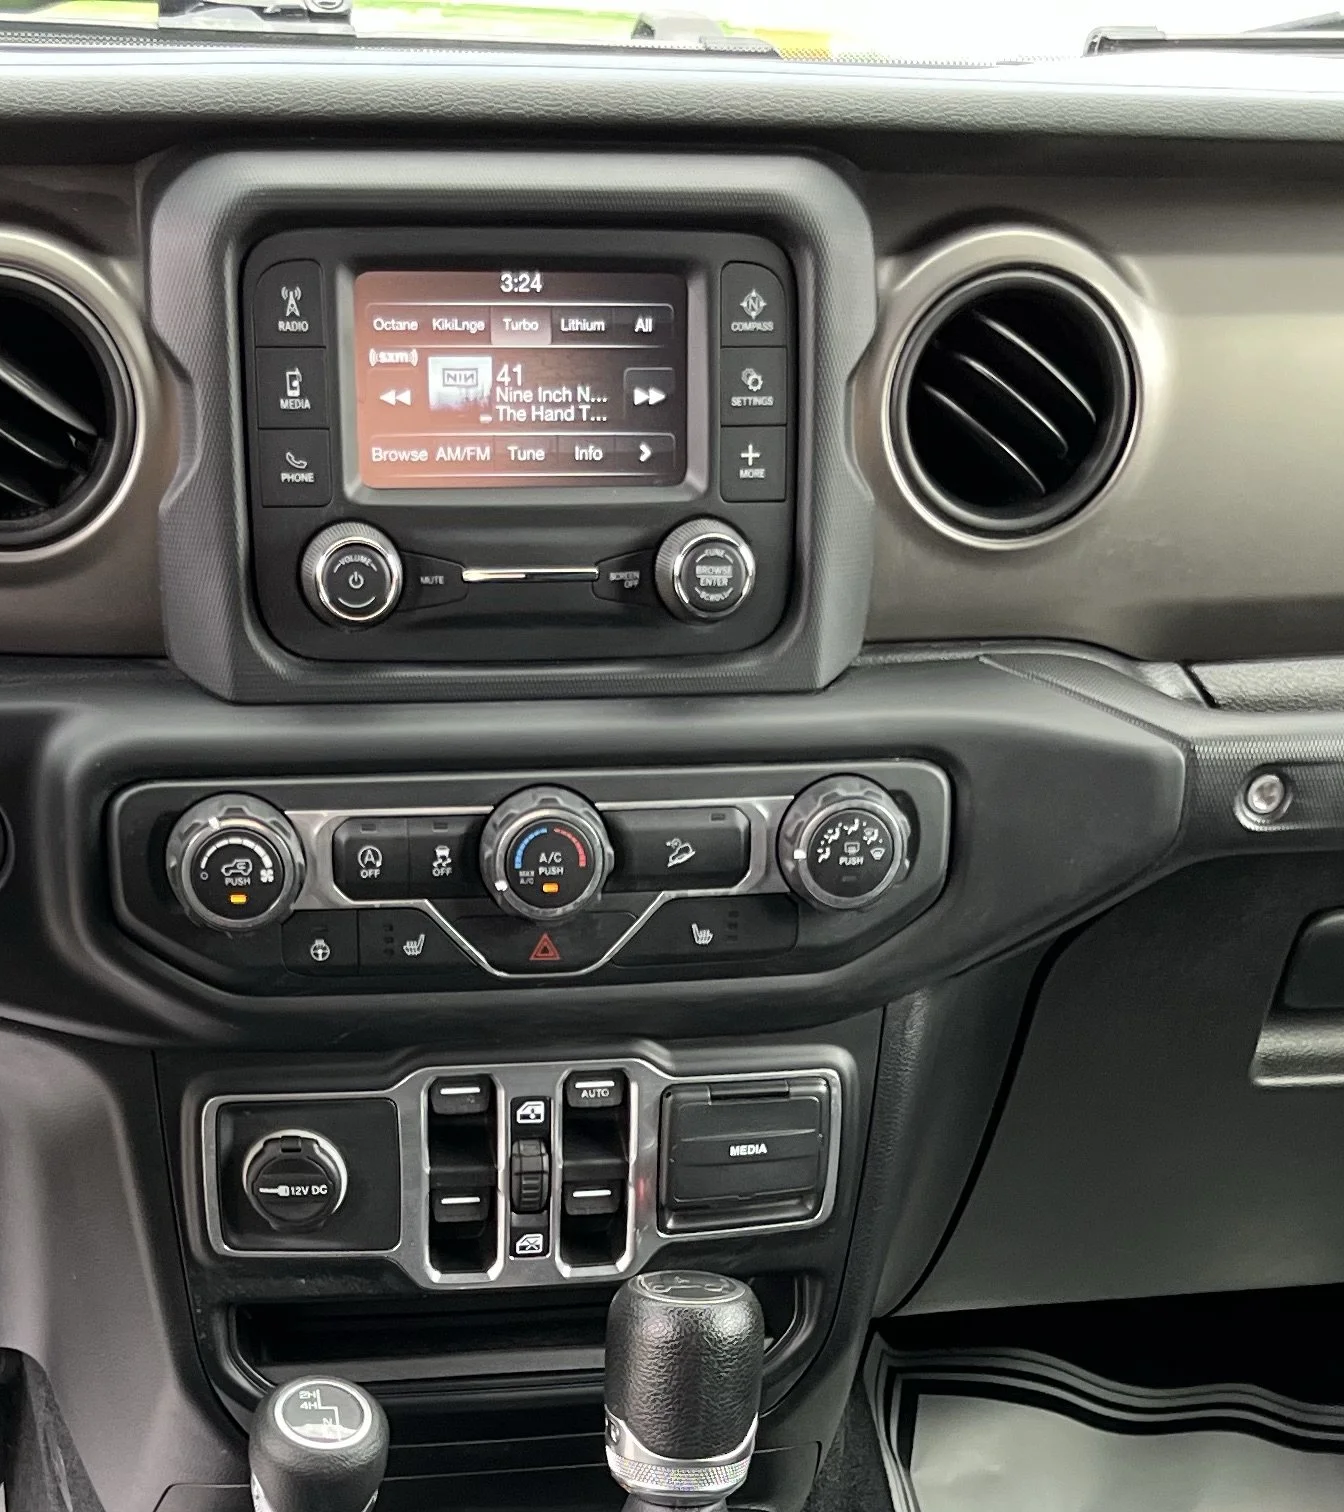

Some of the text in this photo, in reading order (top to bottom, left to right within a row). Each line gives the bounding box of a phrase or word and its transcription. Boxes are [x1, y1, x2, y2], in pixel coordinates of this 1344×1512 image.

[499, 272, 543, 294] 3:24
[277, 320, 309, 333] RADIO
[373, 317, 419, 333] Octane
[502, 318, 539, 333] Turbo
[560, 317, 606, 333] Lithium
[634, 316, 654, 333] All
[730, 321, 774, 332] COMPASS
[496, 364, 524, 387] 41
[496, 387, 533, 404] Nine
[537, 387, 573, 404] Inch
[730, 395, 774, 407] SETTINGS
[279, 398, 311, 410] MEDIA
[496, 405, 527, 422] The
[531, 405, 575, 422] Hand
[371, 446, 428, 463] Browse
[435, 446, 491, 462] AM/FM
[507, 446, 546, 462] Tune
[574, 446, 604, 462] Info
[281, 472, 315, 484] PHONE
[739, 468, 765, 479] MORE
[338, 553, 373, 567] VOLUME
[420, 575, 445, 586] MUTE
[539, 851, 562, 865] A/C
[839, 856, 864, 867] PUSH
[360, 868, 380, 879] OFF
[432, 867, 452, 877] OFF
[538, 866, 564, 876] PUSH
[224, 876, 251, 887] PUSH
[580, 1088, 610, 1099] AUTO
[729, 1142, 768, 1157] MEDIA
[290, 1184, 328, 1196] 12V DC
